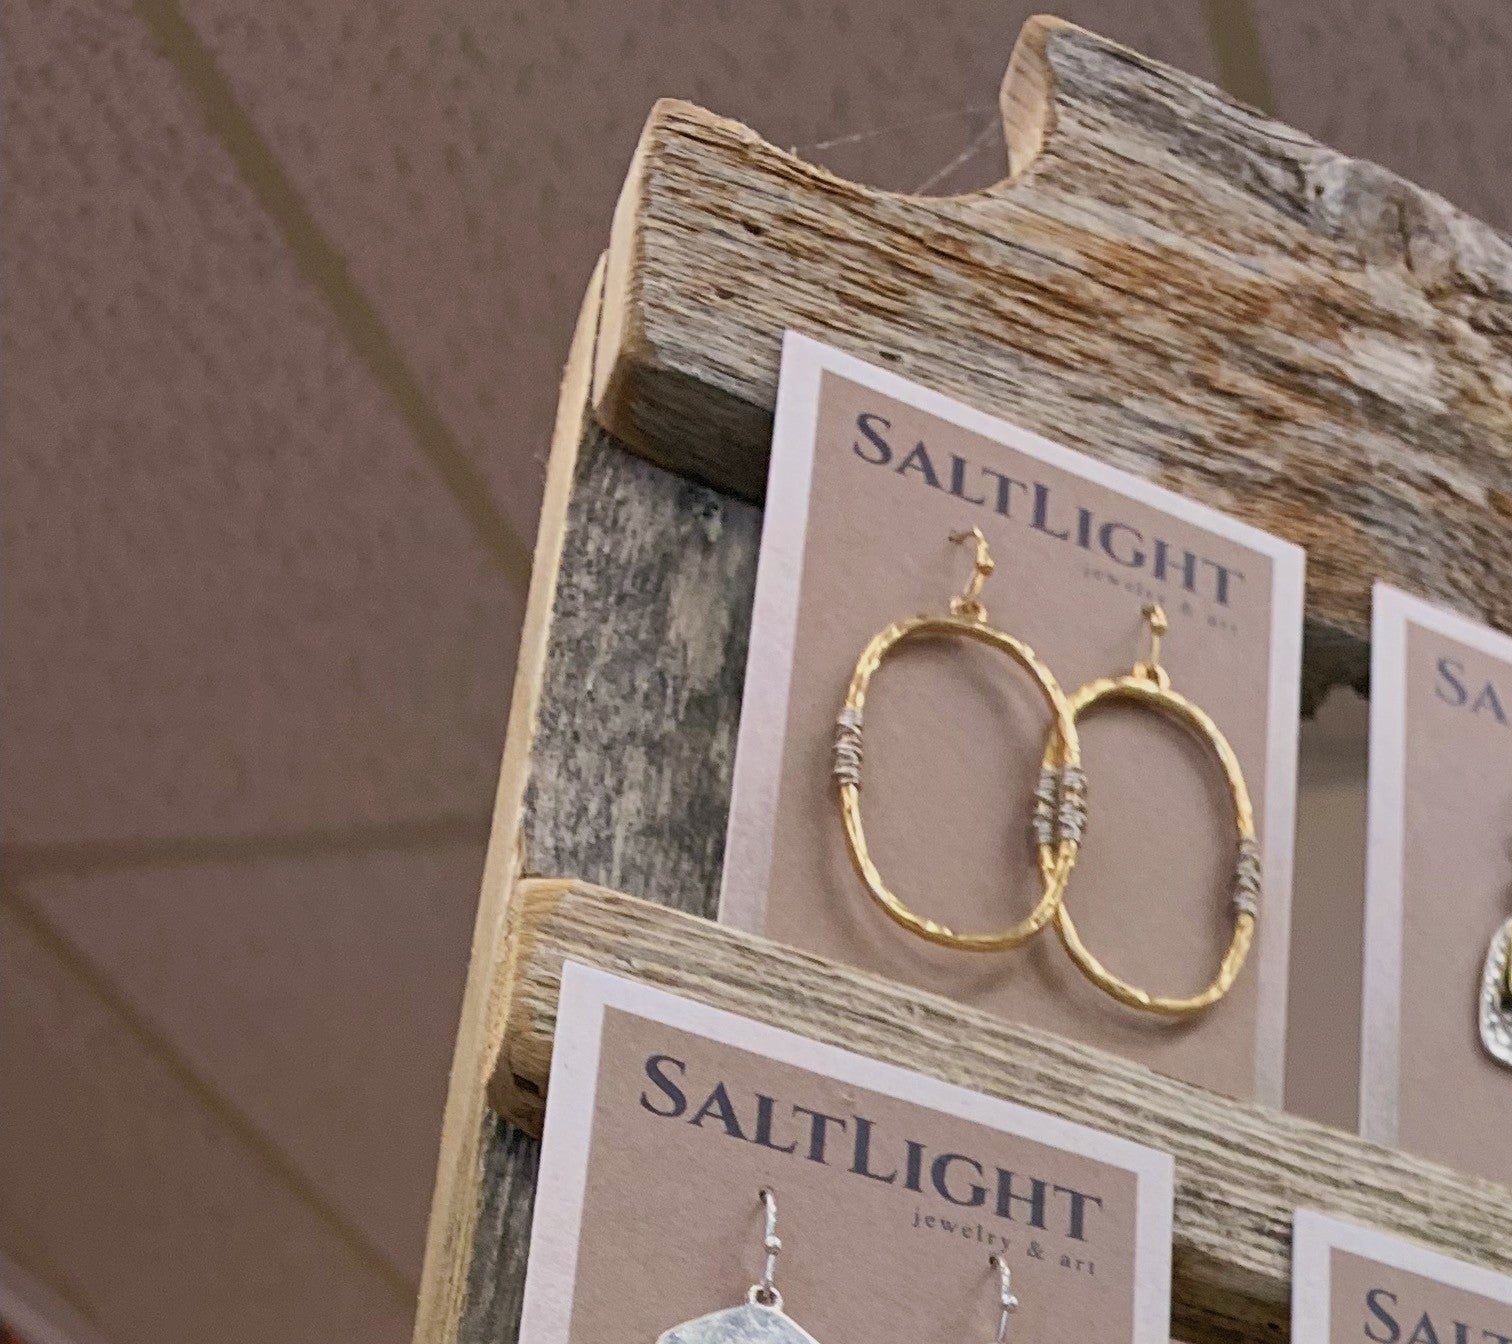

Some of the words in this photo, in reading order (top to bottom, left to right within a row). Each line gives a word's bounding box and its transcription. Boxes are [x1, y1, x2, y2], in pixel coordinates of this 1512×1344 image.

[913, 1206, 1012, 1256] jewelry
[1026, 1238, 1046, 1261] &
[1060, 1251, 1097, 1276] art
